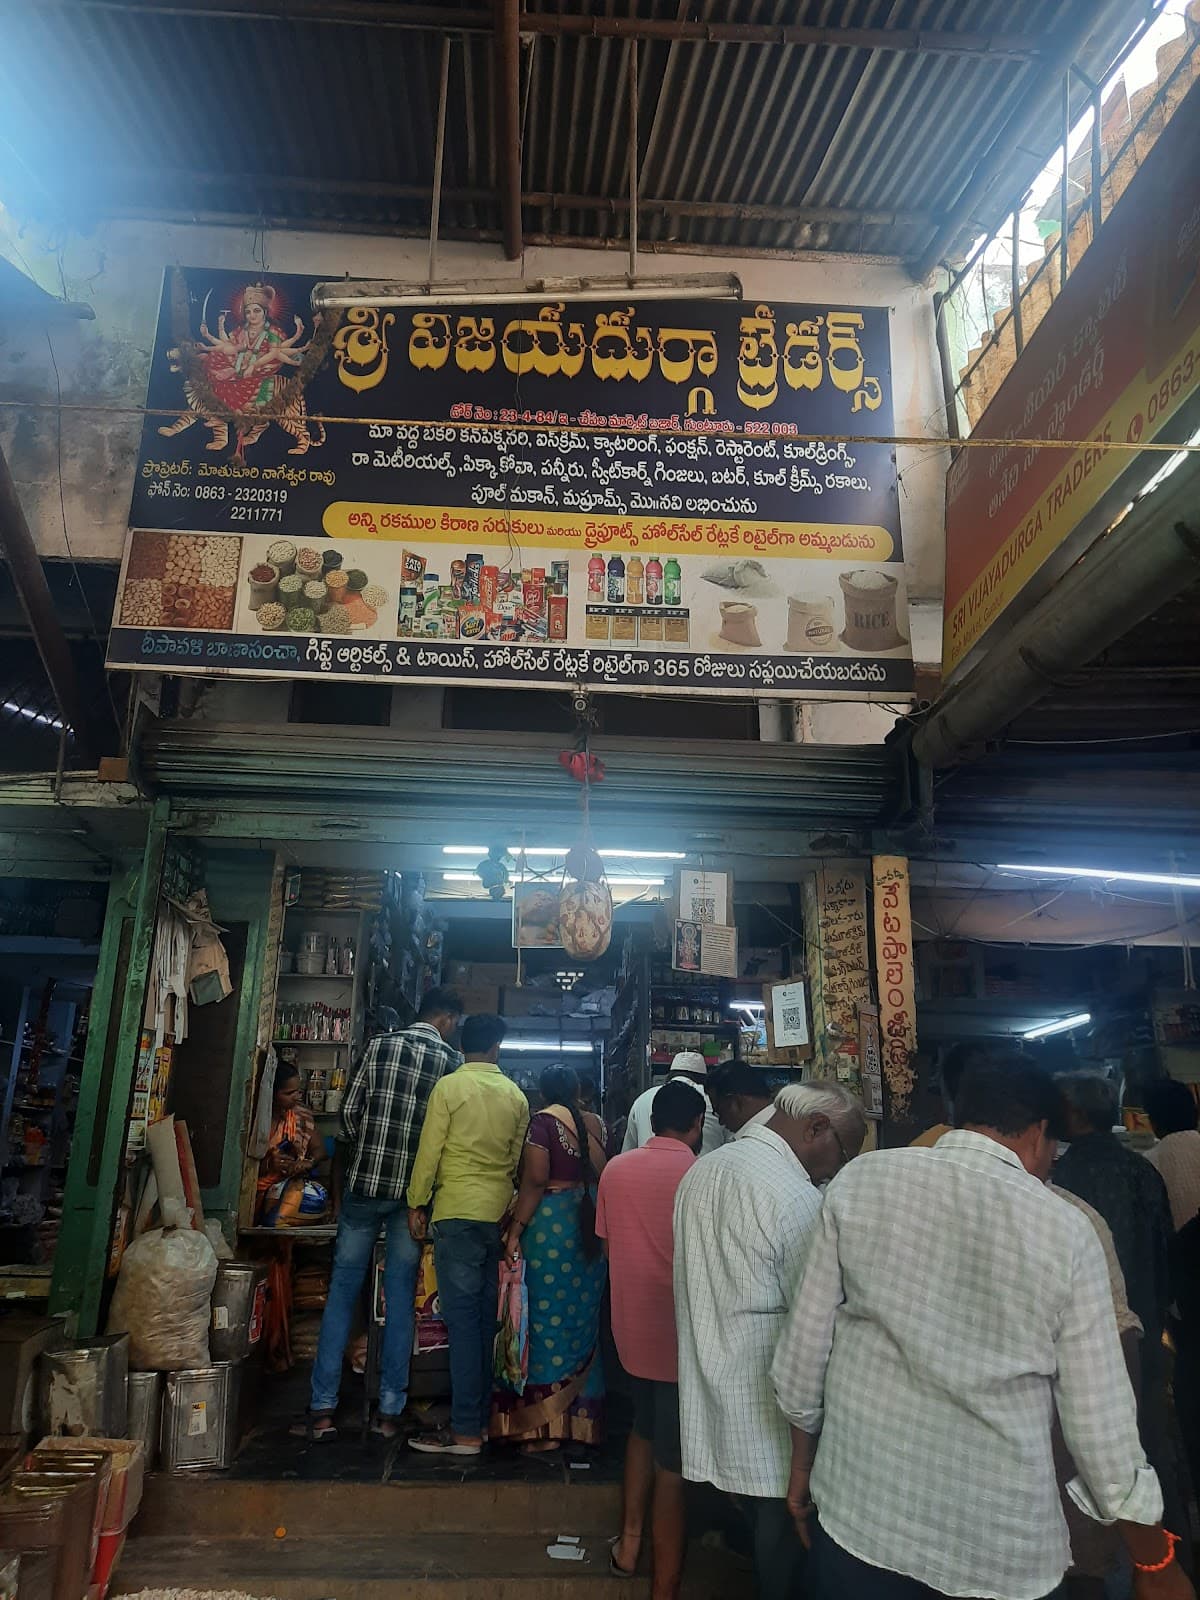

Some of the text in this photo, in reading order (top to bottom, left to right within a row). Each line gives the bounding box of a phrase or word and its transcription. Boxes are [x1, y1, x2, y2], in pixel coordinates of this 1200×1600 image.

[332, 307, 395, 394] శ్రీ
[736, 304, 883, 413] ట్రేడర్స్
[744, 421, 771, 434] 522
[309, 470, 336, 486] రావు
[351, 452, 370, 466] రా
[654, 461, 708, 485] గింజలు,
[711, 466, 750, 487] బటర్,
[753, 468, 787, 486] కూల్
[195, 486, 226, 500] 0863
[235, 488, 288, 503] 2320319
[230, 507, 283, 522] 2211771
[685, 495, 757, 515] లభించును
[348, 511, 377, 534] అన్ని
[380, 513, 437, 530] రకముల
[482, 517, 545, 536] సరుకులు
[546, 526, 582, 537] మరియు
[706, 524, 741, 549] రేట్లకే
[799, 532, 876, 554] అమ్మబడును
[952, 421, 1112, 639] SRI VIJAYADURGA TRADERS
[854, 611, 889, 629] RICE
[337, 643, 393, 673] ఆర్టికల్స్
[396, 647, 412, 666] &
[553, 648, 590, 678] రేట్లకే
[653, 658, 690, 678] 365
[693, 654, 746, 679] రోజులు
